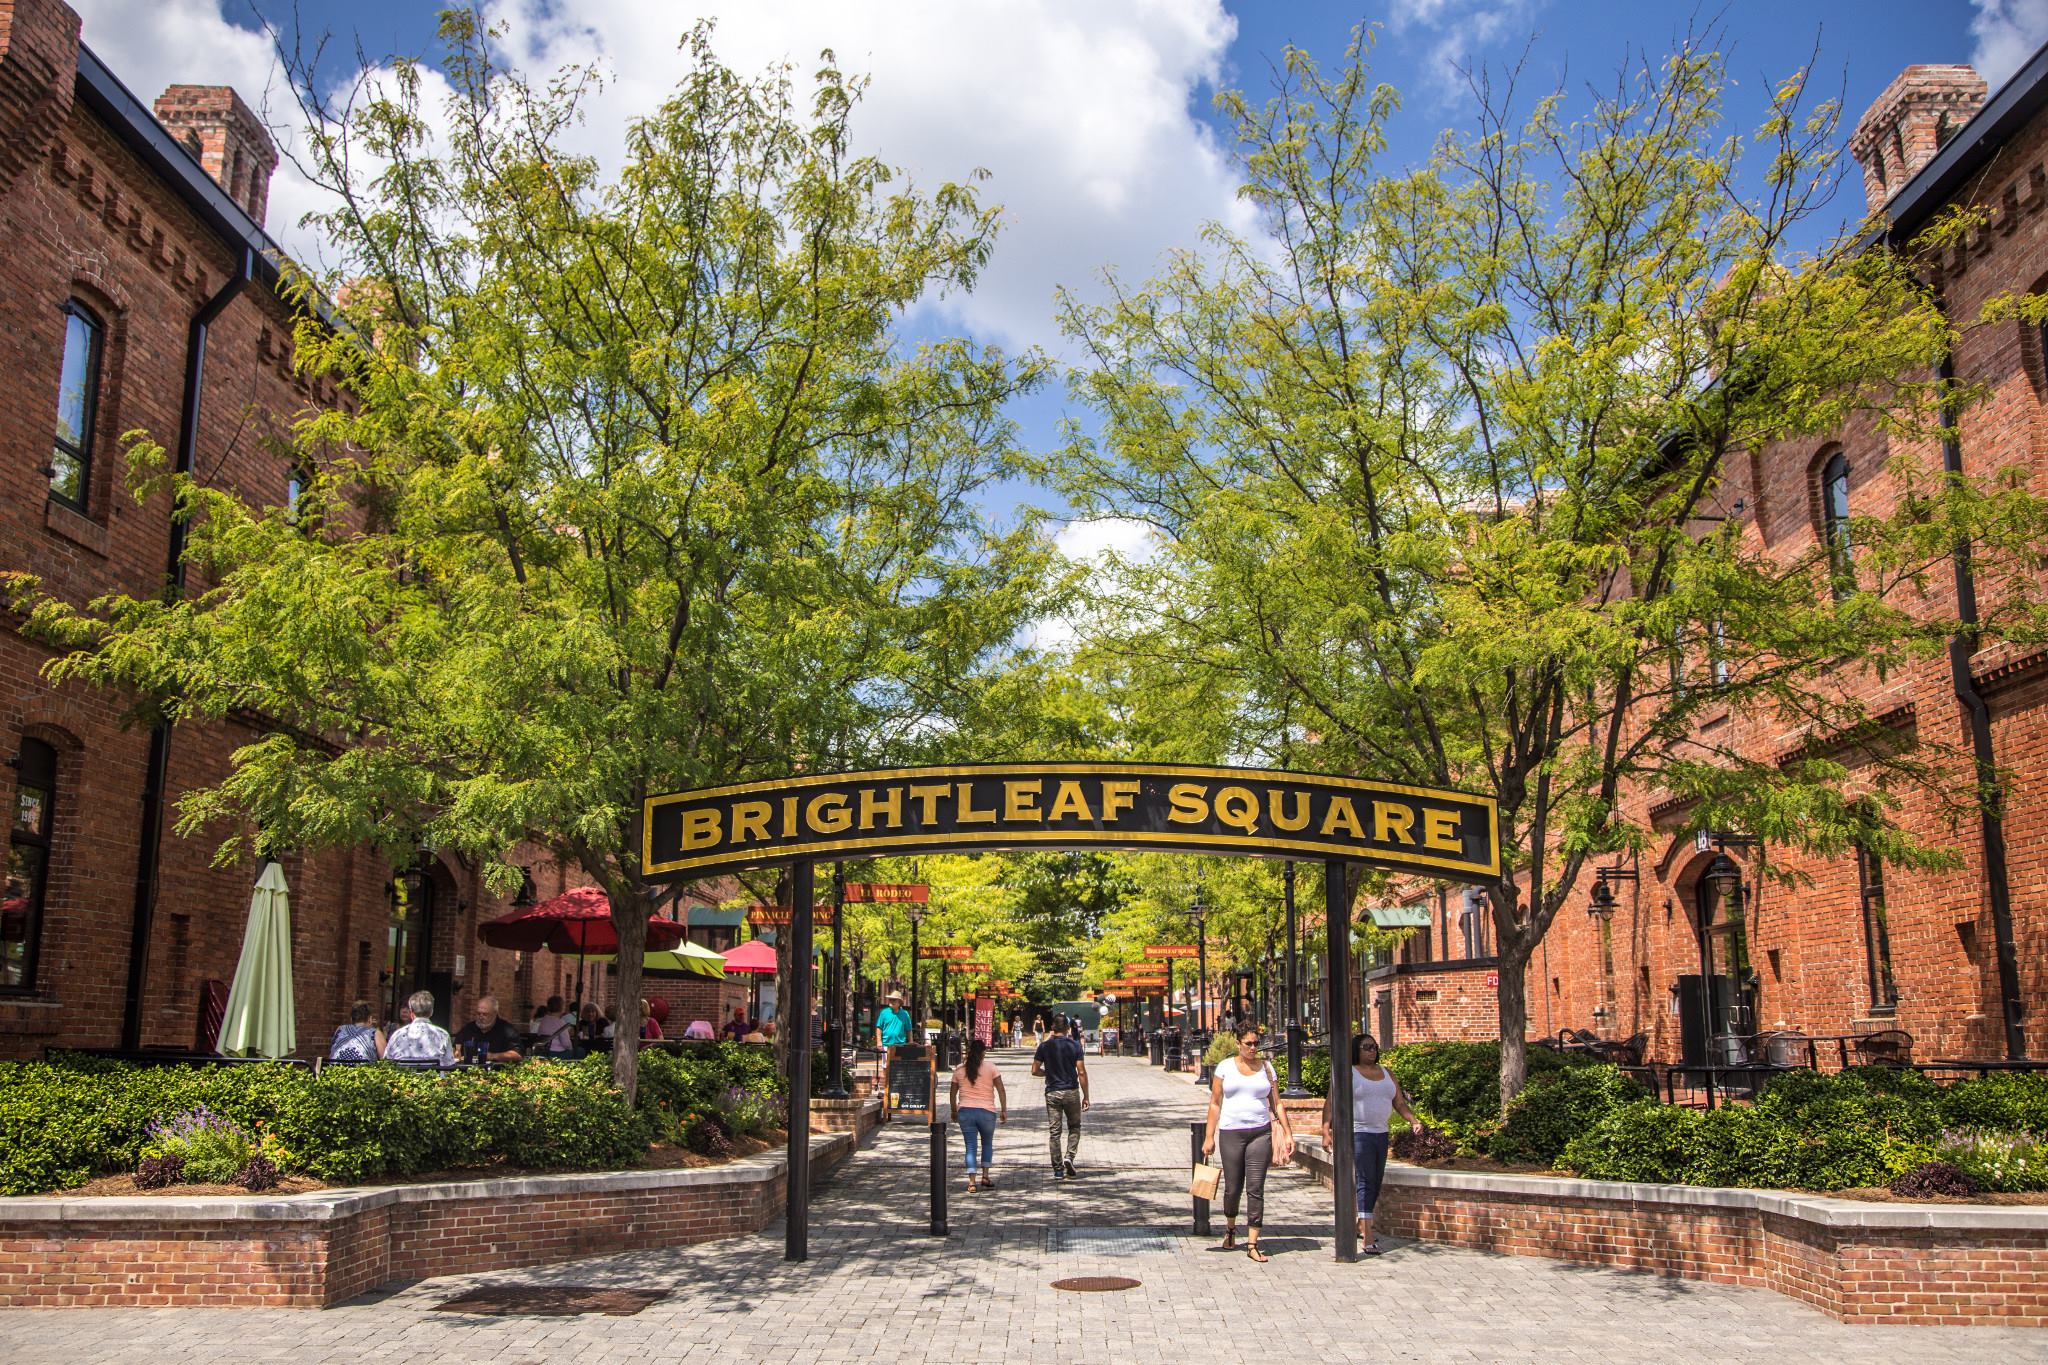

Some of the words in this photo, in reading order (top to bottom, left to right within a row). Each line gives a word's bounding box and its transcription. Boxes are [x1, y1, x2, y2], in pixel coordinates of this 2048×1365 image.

[679, 778, 1142, 852] BRIGHTLEAF
[1167, 782, 1463, 854] SQUARE
[860, 890, 871, 898] EL
[876, 890, 912, 898] RODEO
[976, 1010, 993, 1018] SALE
